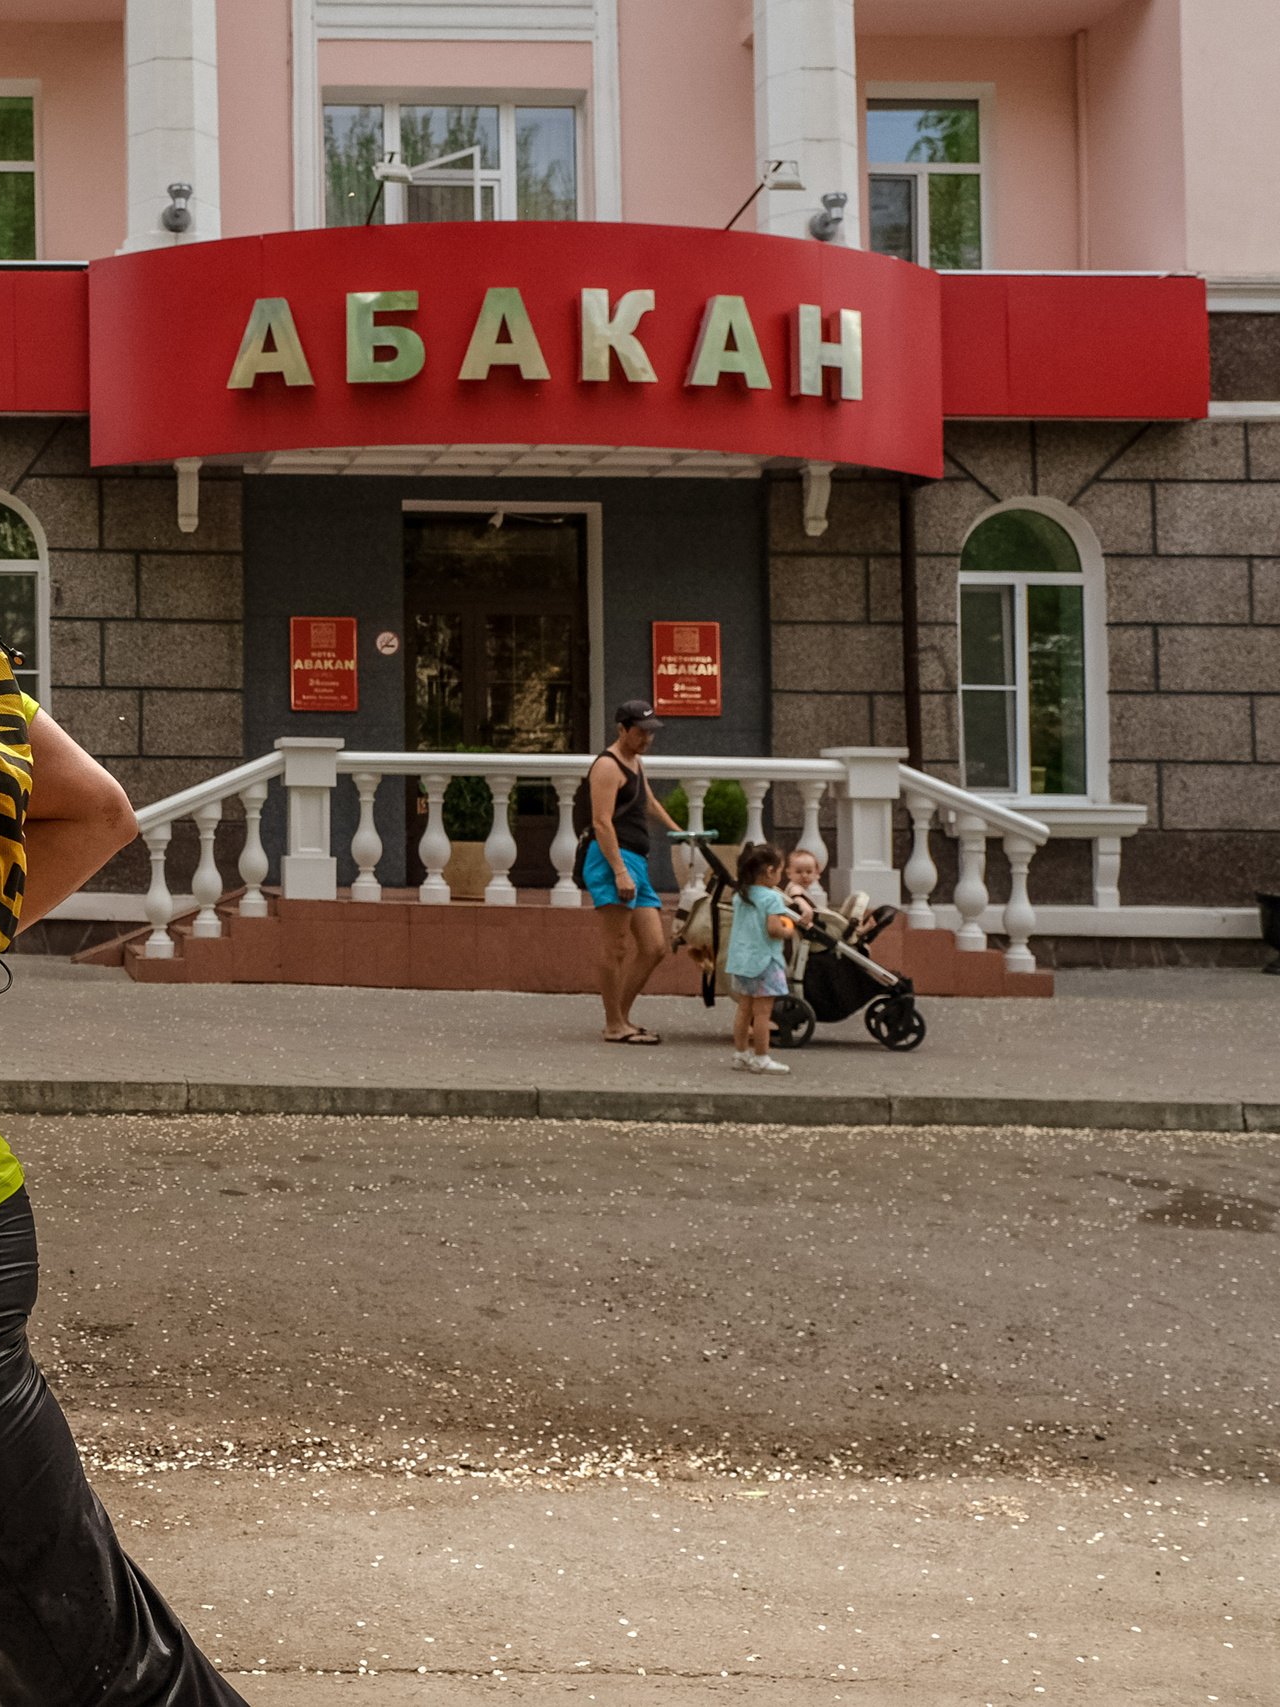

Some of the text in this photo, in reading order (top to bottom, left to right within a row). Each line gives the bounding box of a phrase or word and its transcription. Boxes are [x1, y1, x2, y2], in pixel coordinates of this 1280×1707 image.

[226, 287, 863, 401] АБАКАН
[294, 659, 356, 670] ABAKAN
[657, 663, 718, 676] АБАКАН
